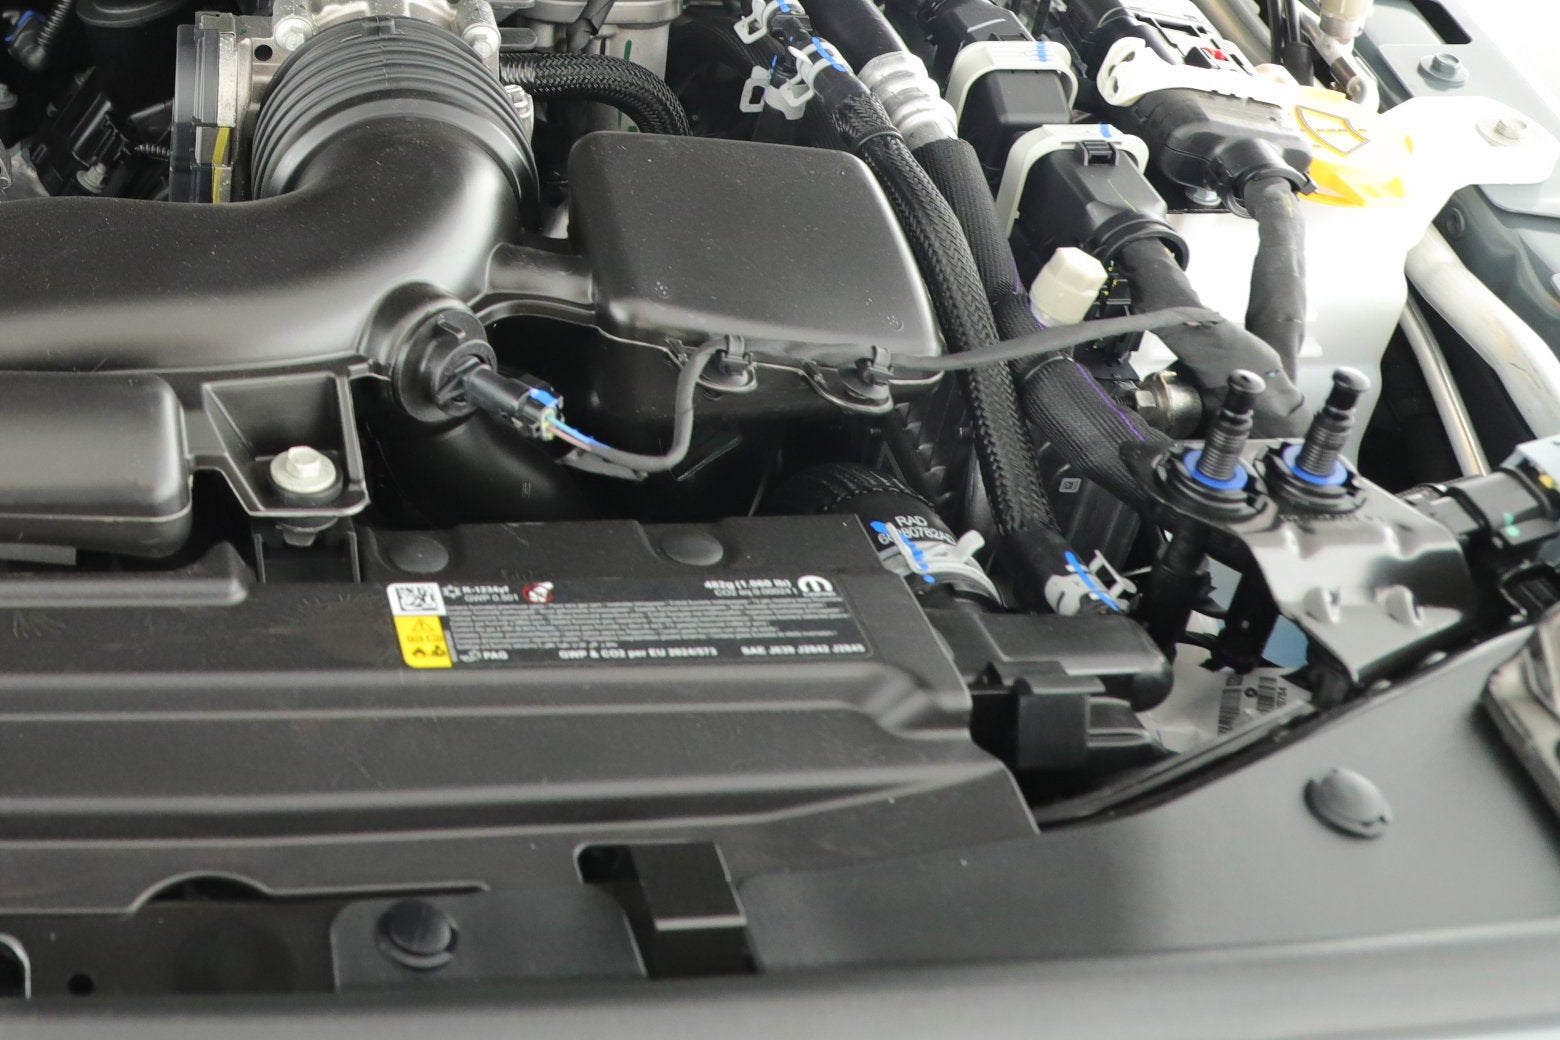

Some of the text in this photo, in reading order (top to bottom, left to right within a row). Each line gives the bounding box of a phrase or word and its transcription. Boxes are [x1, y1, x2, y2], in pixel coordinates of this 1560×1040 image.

[894, 515, 928, 527] RAD
[877, 526, 957, 547] 680782AD
[461, 585, 510, 595] R-1234yf
[464, 594, 491, 603] GWP
[483, 650, 509, 660] PAG
[558, 649, 588, 659] GWP
[600, 649, 627, 658] CO2
[627, 649, 647, 659] per
[647, 647, 667, 657] EU
[741, 645, 768, 656] SAE
